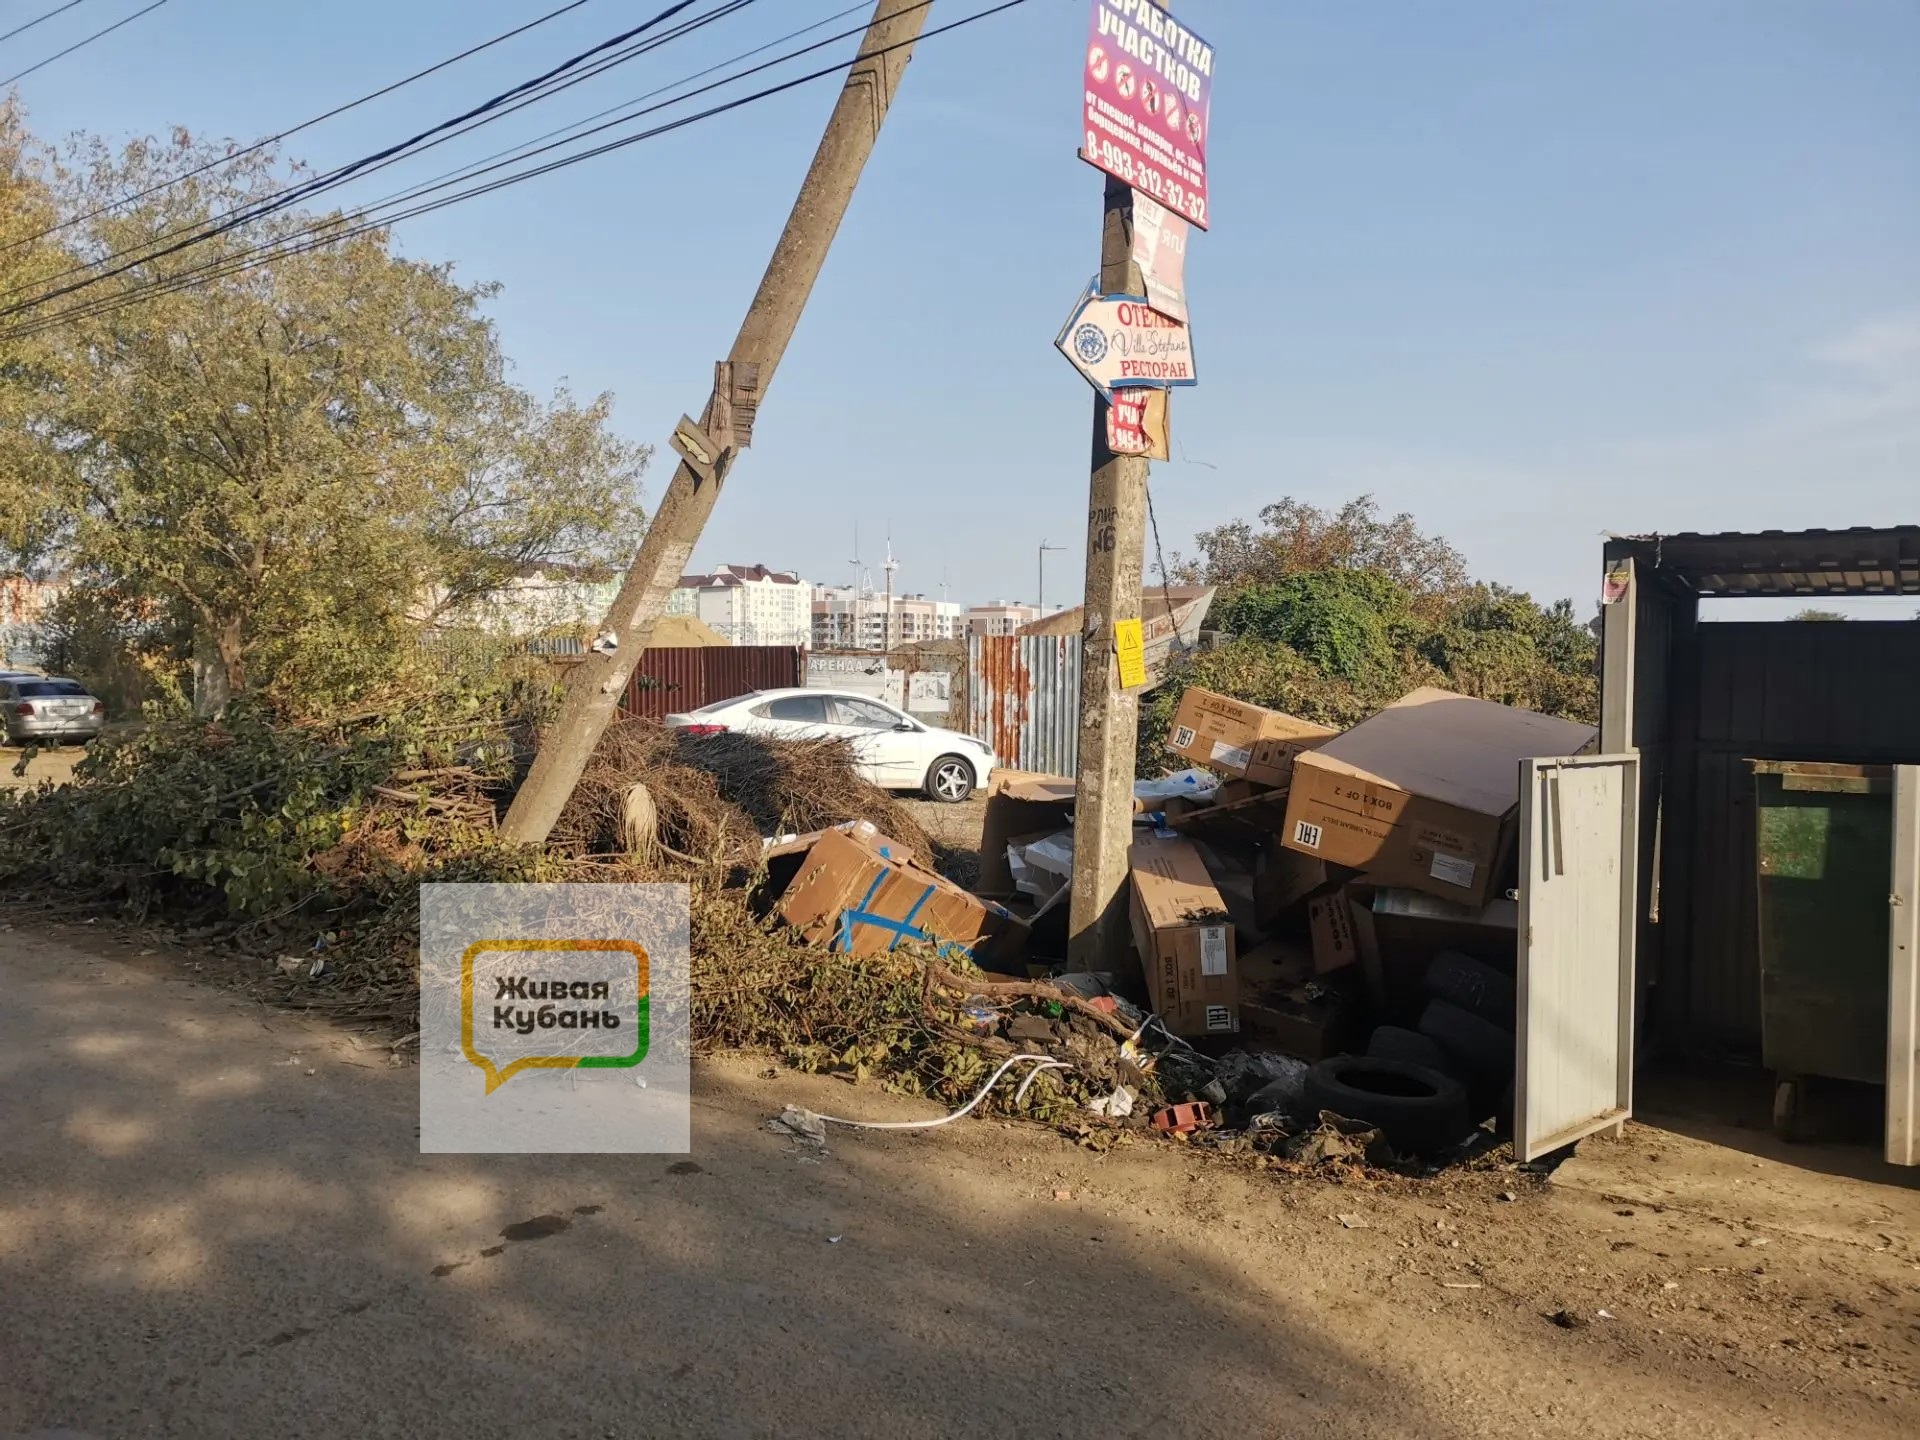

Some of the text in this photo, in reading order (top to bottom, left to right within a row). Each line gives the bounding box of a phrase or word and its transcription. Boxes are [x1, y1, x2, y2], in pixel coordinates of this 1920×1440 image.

[1098, 4, 1200, 101] УЧАСТКОВ
[1087, 130, 1206, 223] 8-993-312-32-32
[1120, 360, 1187, 377] РЕСТОРАН
[809, 659, 864, 674] АРЕНДА
[1334, 786, 1341, 796] 2
[1345, 790, 1360, 800] OF
[1370, 796, 1393, 810] BOX
[1297, 823, 1318, 846] EAC
[1164, 956, 1174, 976] BOX
[1208, 1007, 1229, 1027] EAC
